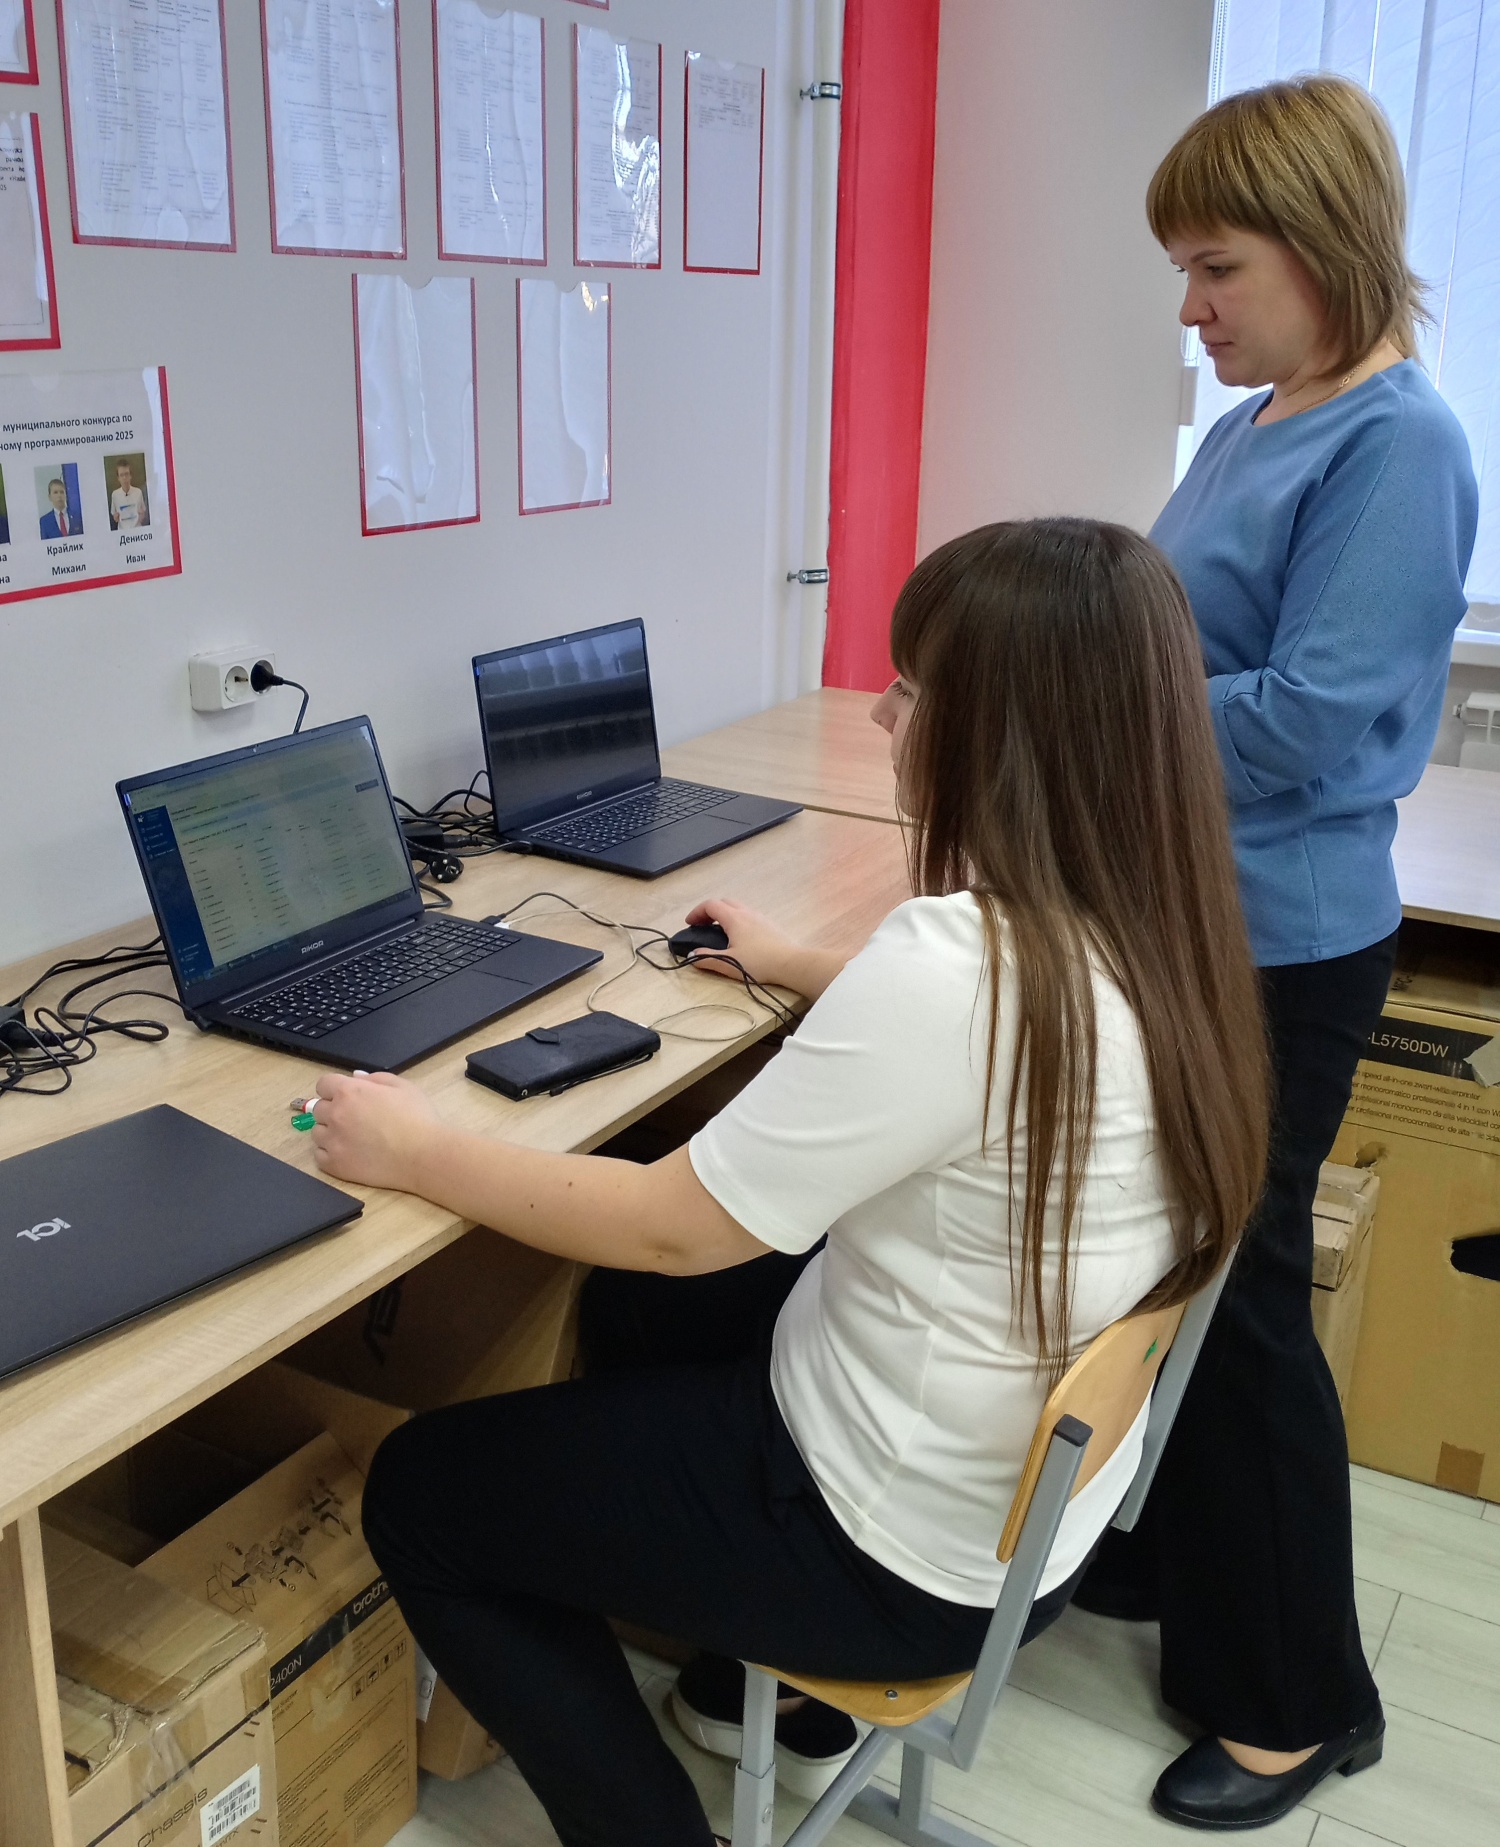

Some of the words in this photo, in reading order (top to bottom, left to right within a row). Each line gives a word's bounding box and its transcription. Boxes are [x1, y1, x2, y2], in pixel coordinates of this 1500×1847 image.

[2, 418, 81, 434] муниципального
[82, 414, 121, 428] конкурса
[121, 413, 133, 424] по
[24, 434, 114, 450] программированию
[115, 430, 134, 441] 2025
[119, 531, 153, 546] Денисов
[46, 542, 84, 556] Крайлих
[125, 553, 146, 564] Иван
[51, 563, 87, 576] Михаил
[137, 1788, 208, 1847] Chassis
